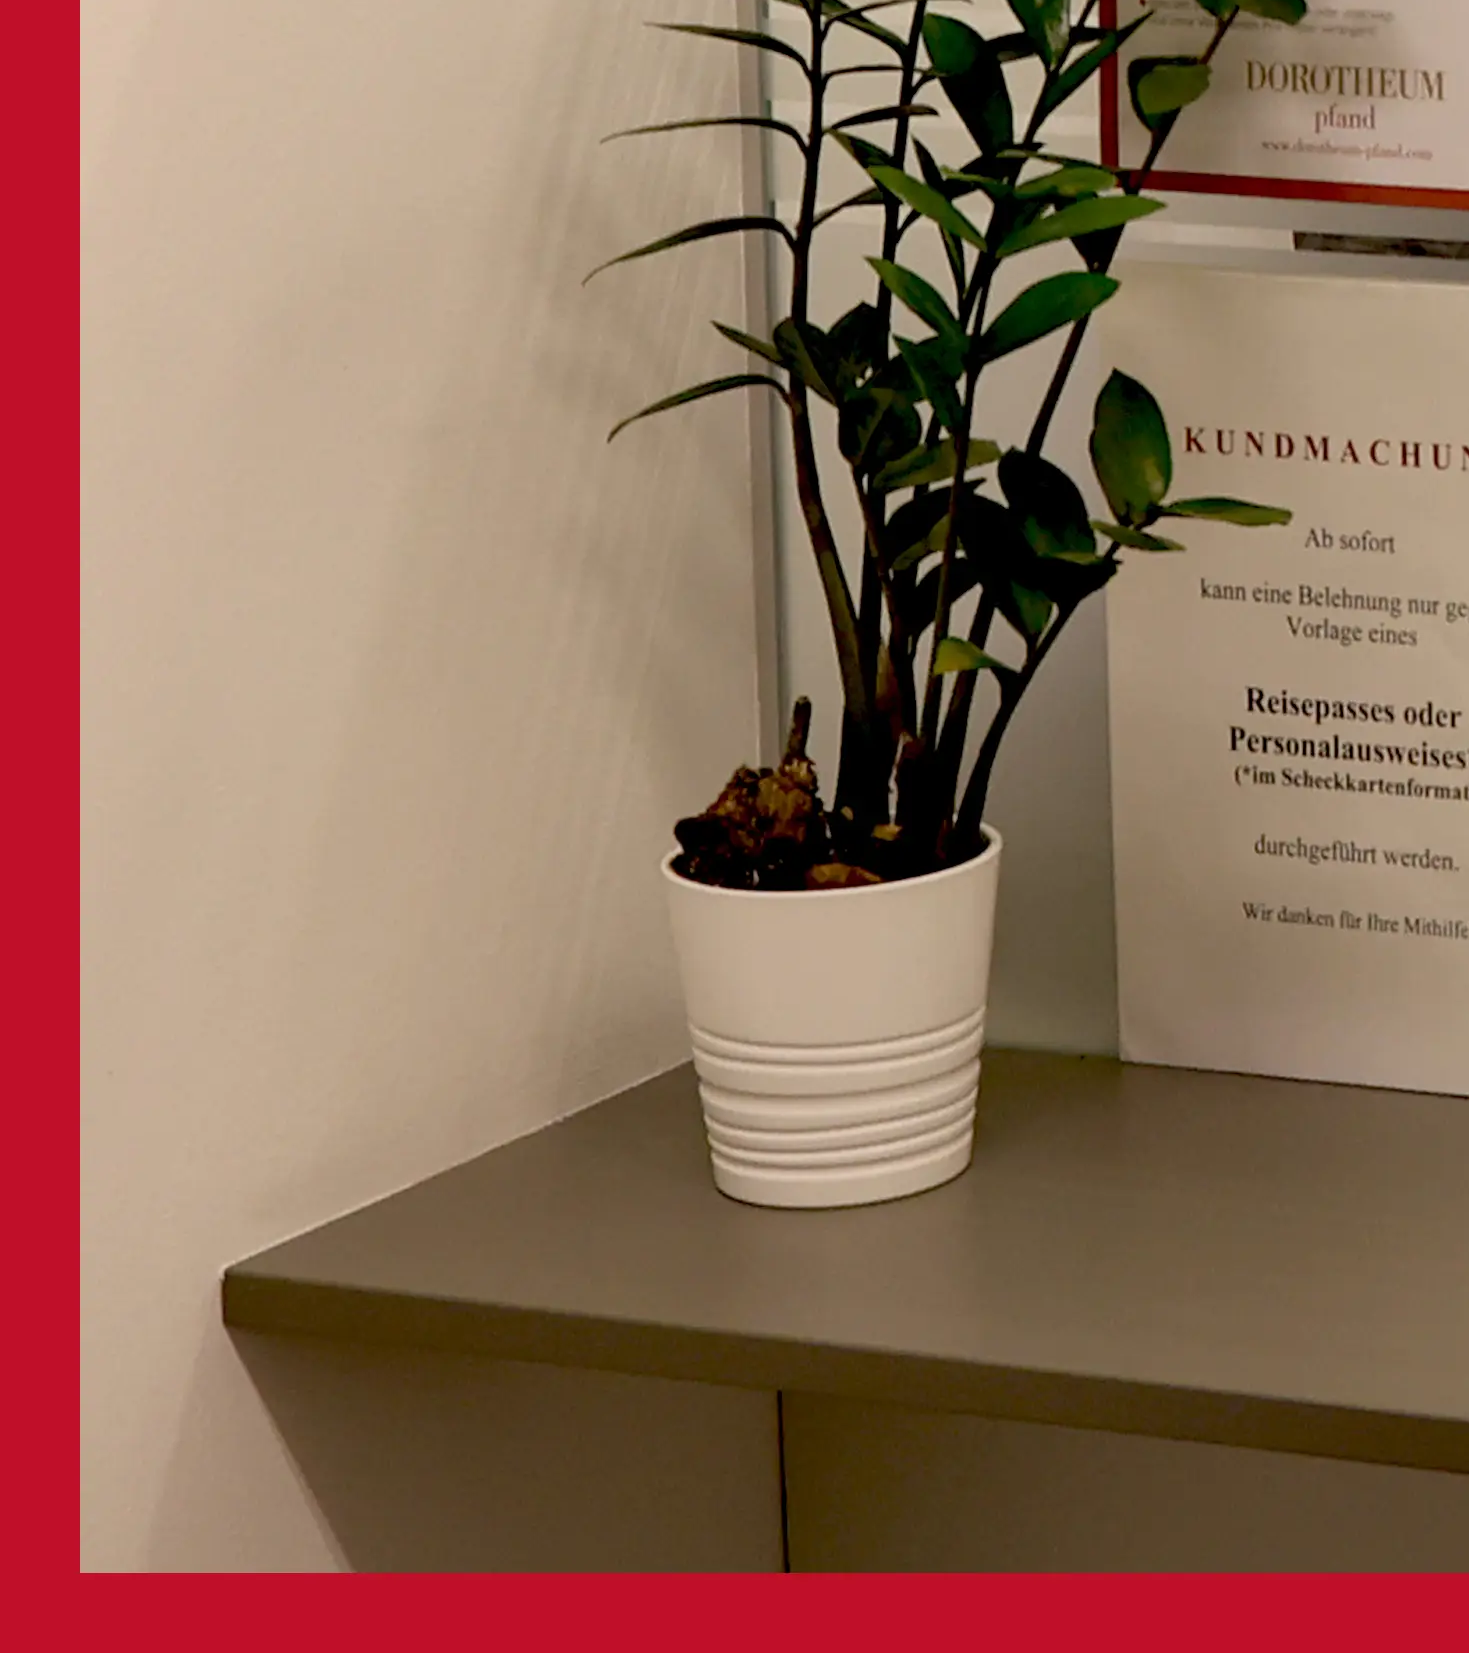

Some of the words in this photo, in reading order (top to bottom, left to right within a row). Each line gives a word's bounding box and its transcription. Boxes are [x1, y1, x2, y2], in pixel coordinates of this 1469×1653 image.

[1245, 59, 1446, 102] DOROTHEUM
[1314, 104, 1376, 133] pfand
[1304, 528, 1335, 549] Ab
[1339, 530, 1396, 554] sofort
[1200, 578, 1247, 603] kann
[1252, 582, 1292, 606] eine
[1298, 584, 1402, 618] Belehnung
[1407, 595, 1440, 617] nur
[1286, 614, 1364, 647] Vorlage
[1368, 623, 1419, 647] eines
[1245, 686, 1396, 726] Reisepasses
[1402, 701, 1463, 729] oder
[1253, 834, 1378, 868] durchgeführt
[1383, 848, 1460, 873] werden.
[1242, 900, 1275, 924] Wir
[1276, 904, 1336, 930] danken
[1340, 908, 1363, 932] für
[1366, 912, 1400, 935] Ihre
